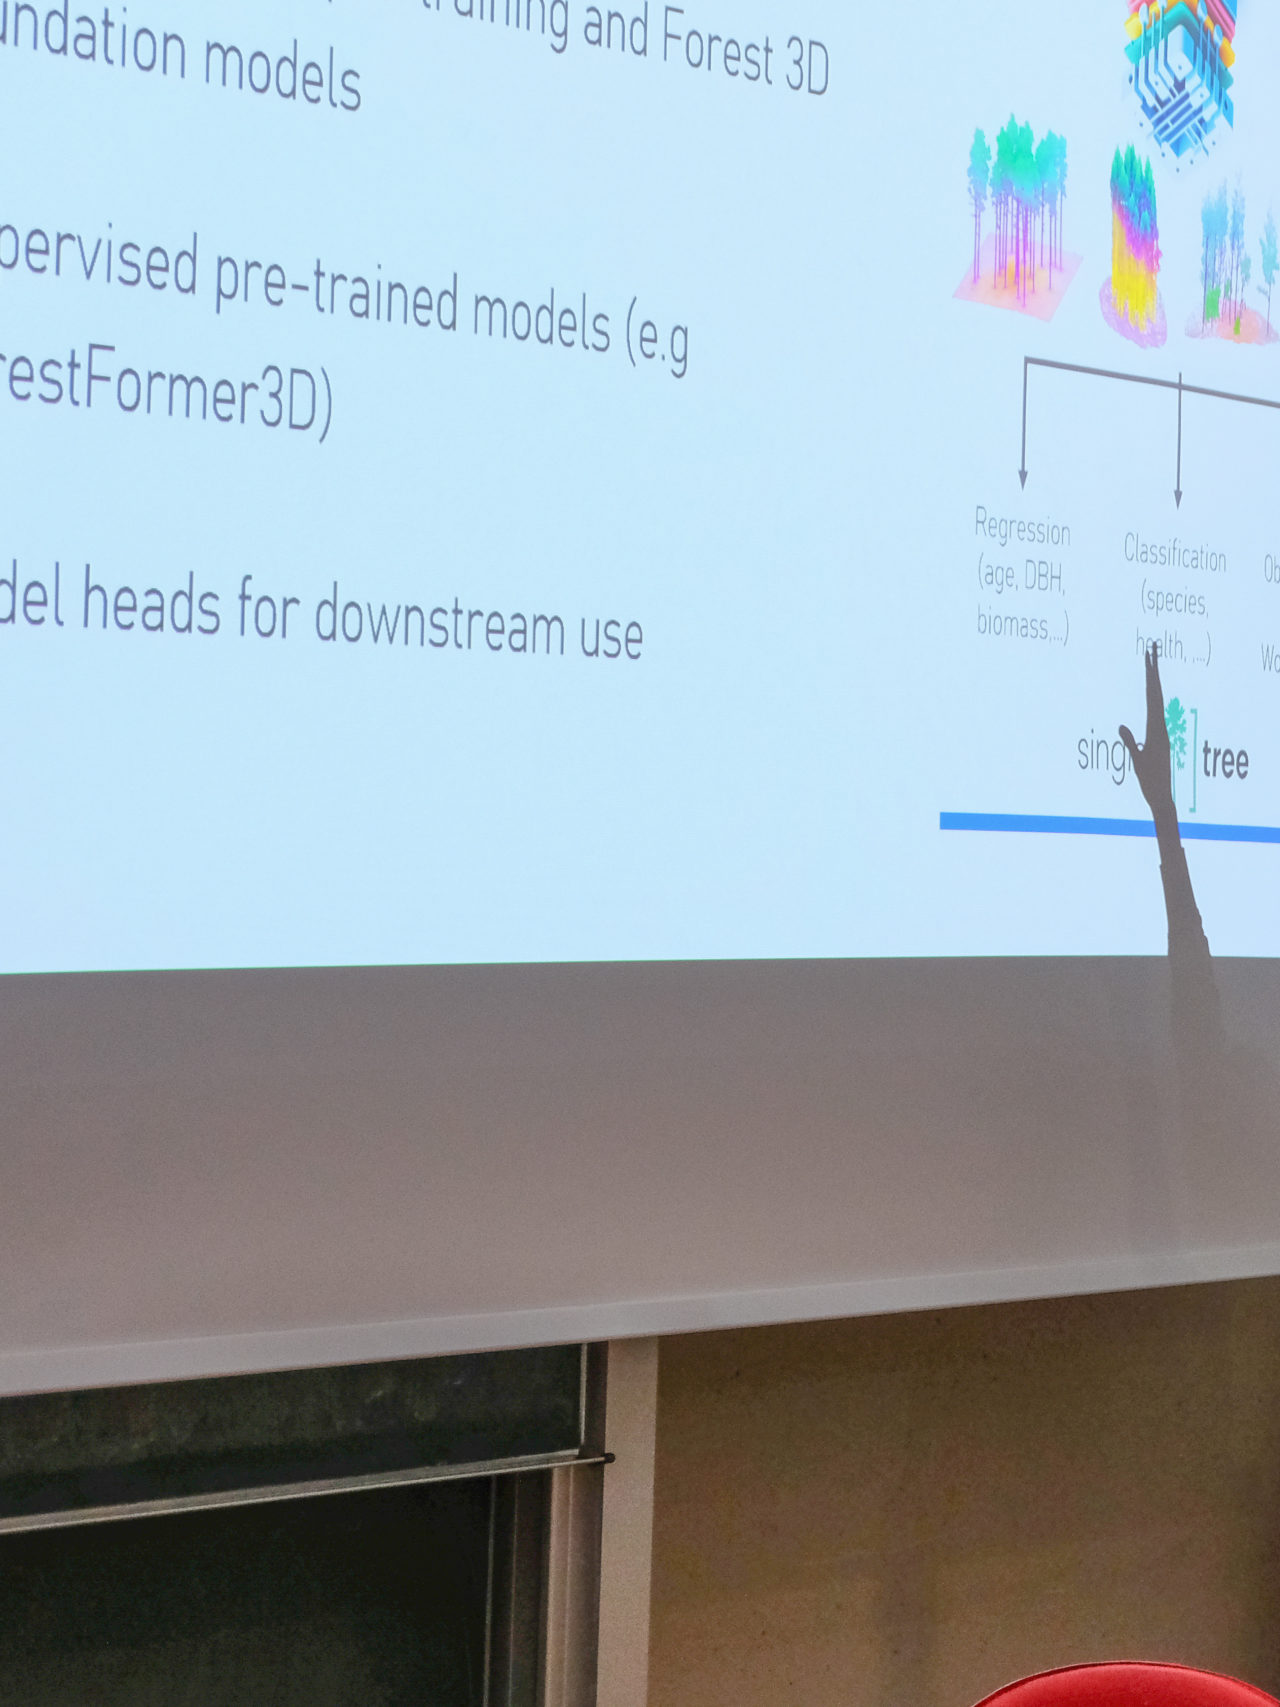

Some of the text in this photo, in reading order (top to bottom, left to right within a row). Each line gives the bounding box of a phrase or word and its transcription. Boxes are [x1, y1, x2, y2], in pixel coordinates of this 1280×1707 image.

[0, 0, 362, 112] ndation models
[584, 0, 648, 57] and
[663, 5, 773, 86] Forest
[786, 35, 829, 96] 3D
[216, 255, 458, 331] pre-trained
[474, 287, 610, 352] models
[626, 296, 689, 379] (e.g
[0, 343, 332, 444] estFormer3D)
[975, 505, 1071, 547] Regression
[1124, 532, 1227, 573] Classification
[978, 551, 1066, 597] (age, DBH,
[1141, 577, 1209, 620] (species,
[83, 563, 221, 635] heads
[238, 574, 301, 639] for
[315, 580, 565, 656] downstream
[581, 617, 643, 660] use
[1202, 740, 1250, 780] tree
